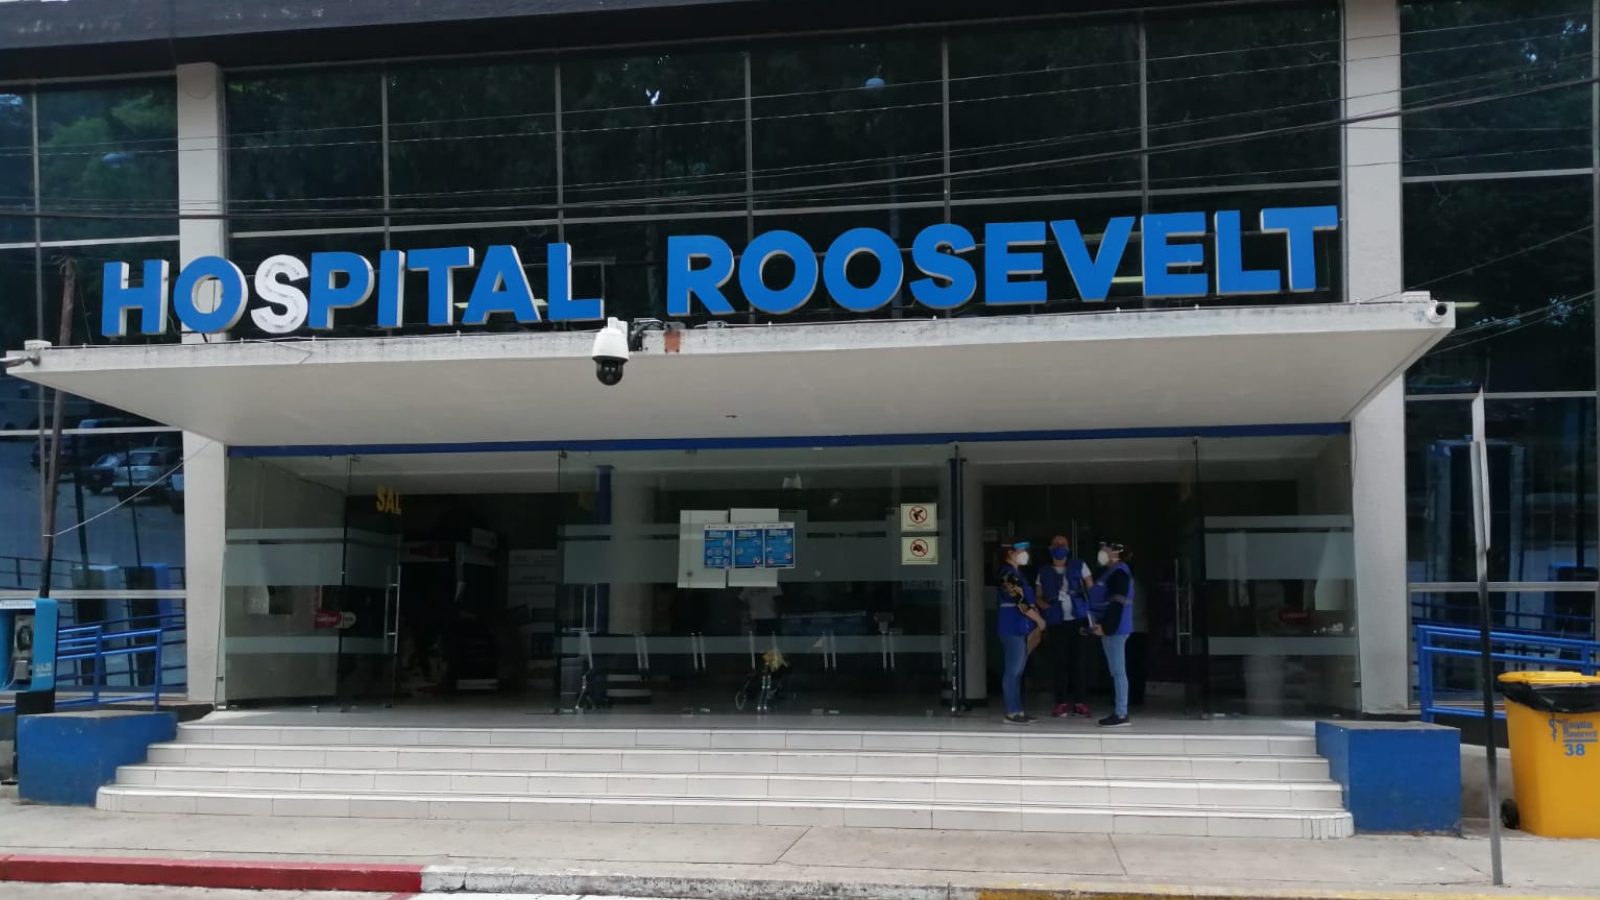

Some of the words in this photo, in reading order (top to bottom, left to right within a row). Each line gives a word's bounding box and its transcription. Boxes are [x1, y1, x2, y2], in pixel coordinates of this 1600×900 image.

[101, 243, 604, 336] HOSPITAL
[667, 205, 1339, 317] ROOSEVELT
[1565, 743, 1584, 755] 38
